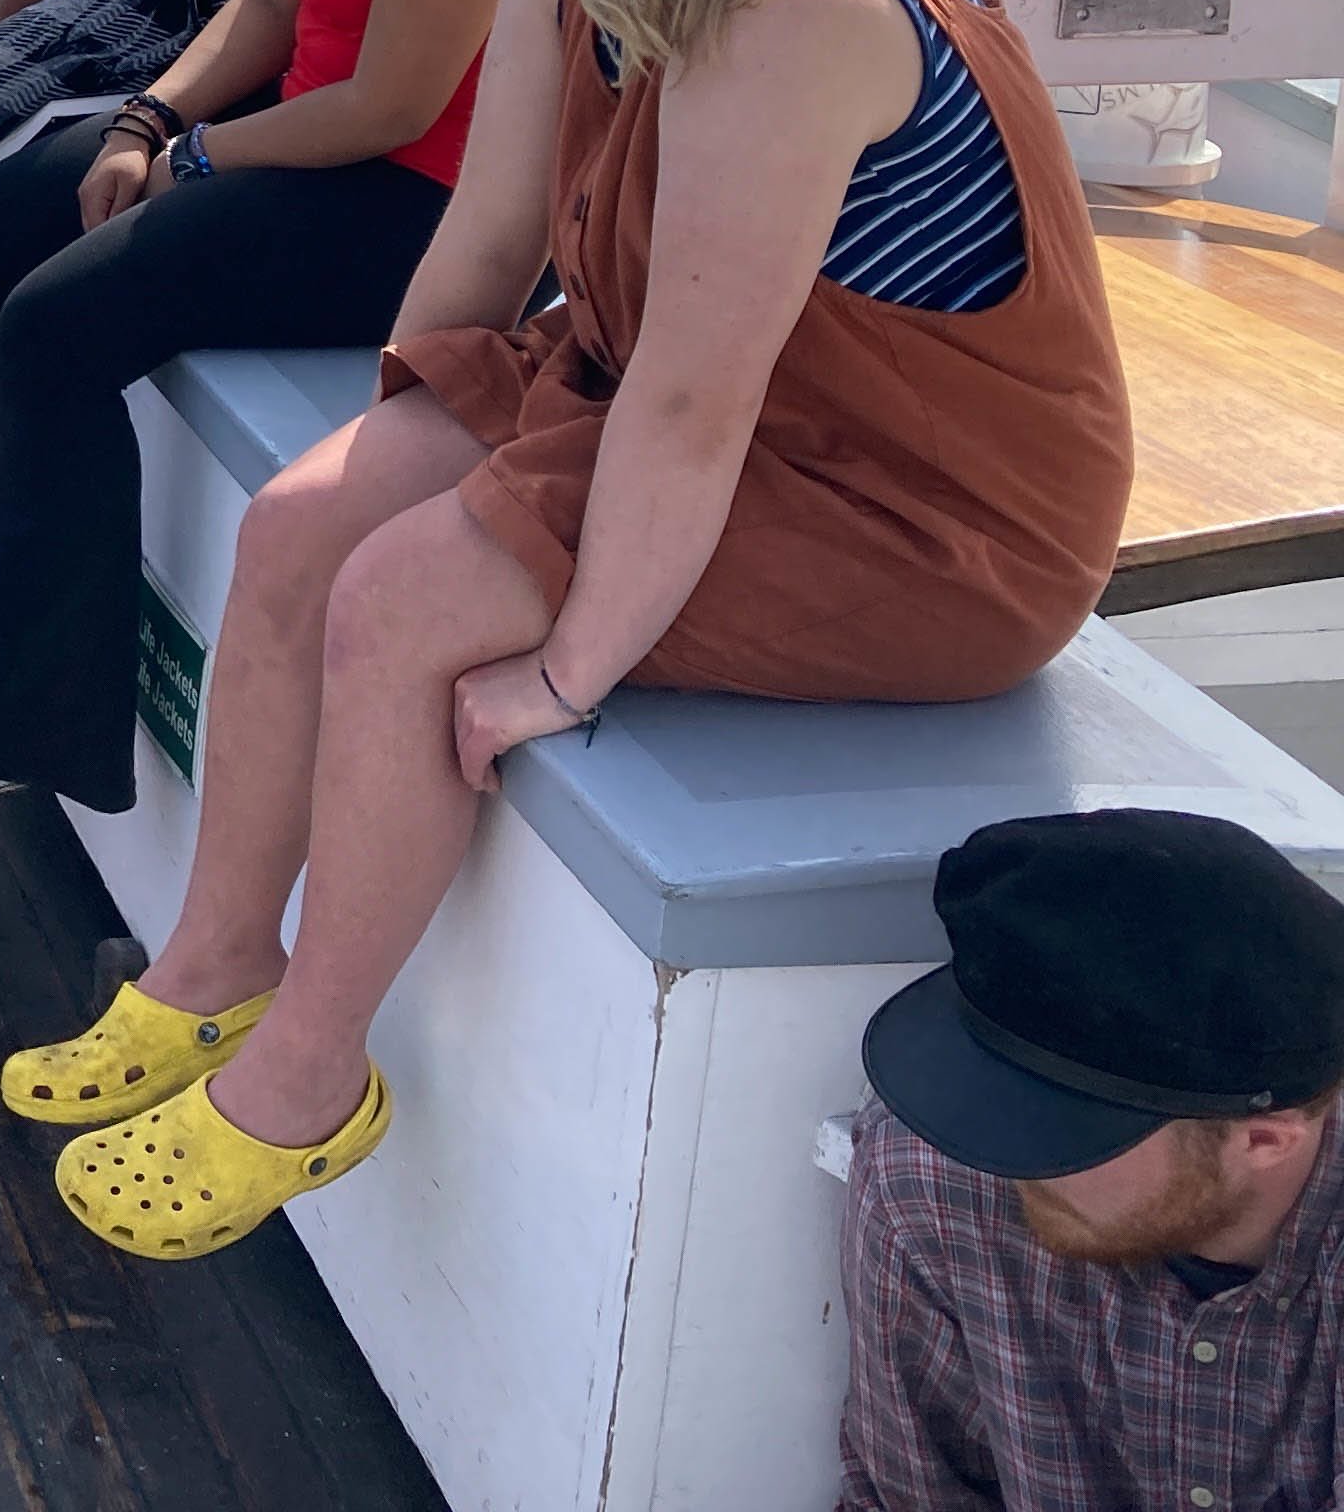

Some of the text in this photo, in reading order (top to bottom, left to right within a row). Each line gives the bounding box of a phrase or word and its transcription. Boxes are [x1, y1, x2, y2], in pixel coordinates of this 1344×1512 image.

[137, 657, 195, 752] ife Jackets
[138, 610, 199, 710] Life Jackets
